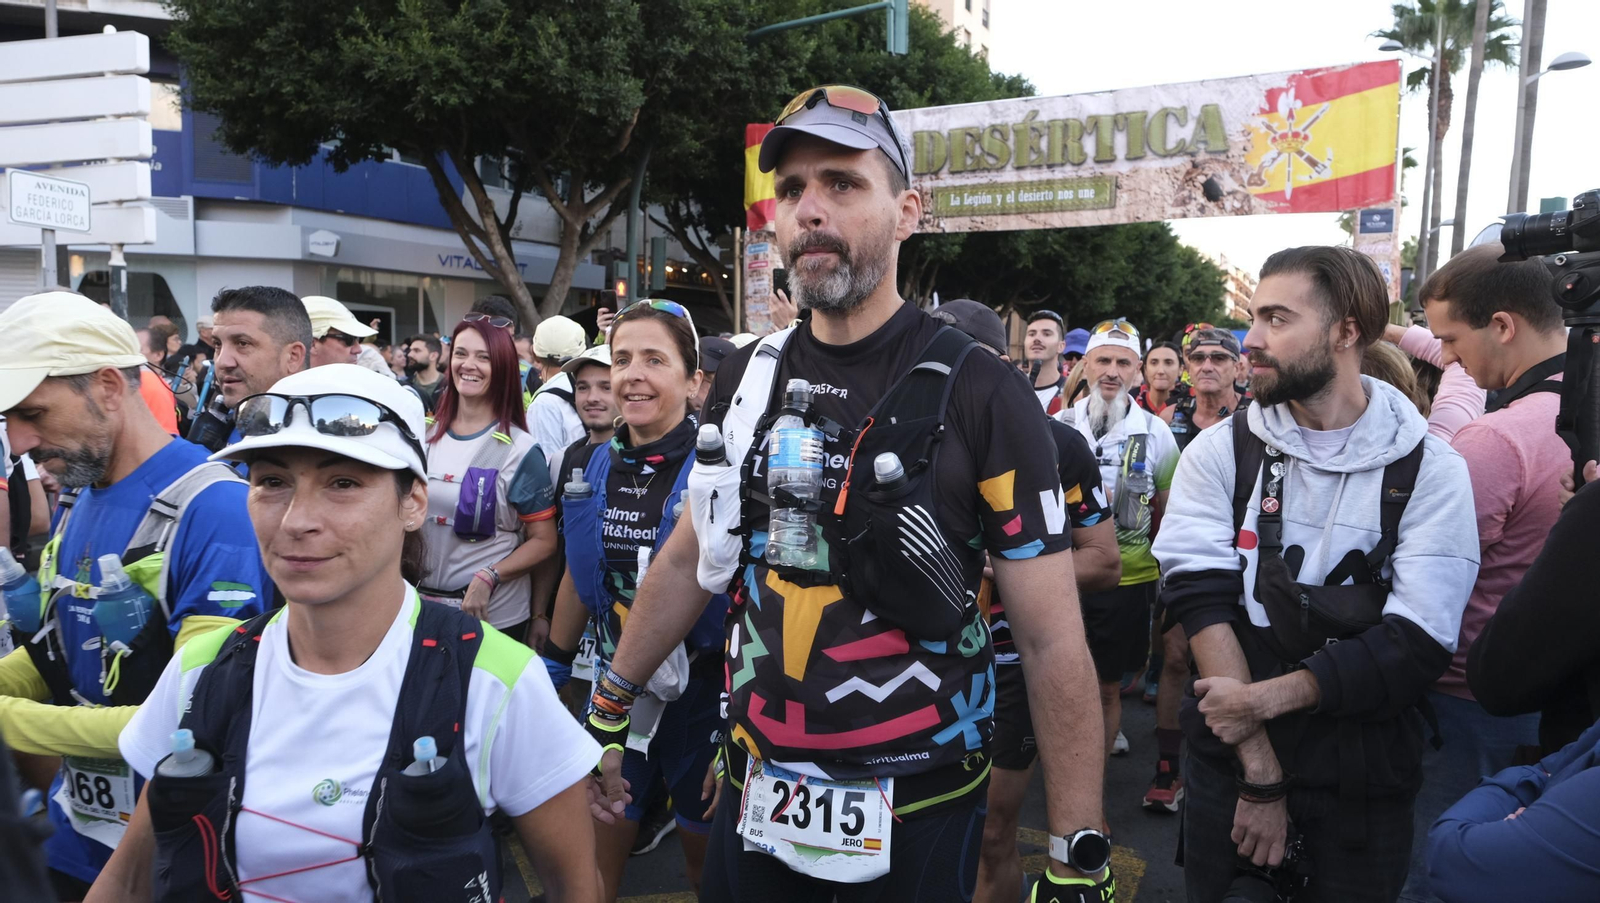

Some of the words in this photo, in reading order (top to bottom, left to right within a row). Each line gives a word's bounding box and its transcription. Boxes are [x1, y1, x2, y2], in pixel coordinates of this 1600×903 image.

[911, 104, 1231, 176] DESÉRTICA
[34, 181, 86, 198] AVENIDA
[950, 193, 961, 206] La
[963, 192, 993, 207] Legión
[996, 193, 1003, 206] y
[1006, 190, 1015, 203] el
[1018, 189, 1054, 203] desierto
[1058, 188, 1074, 200] nos
[1078, 188, 1096, 199] une
[27, 193, 74, 212] FEDERICO
[15, 206, 52, 222] GARCÍA
[54, 212, 85, 227] LORCA
[809, 383, 848, 399] FASTER
[769, 780, 866, 837] 2315
[749, 828, 764, 838] BUS
[841, 837, 863, 848] JERO
